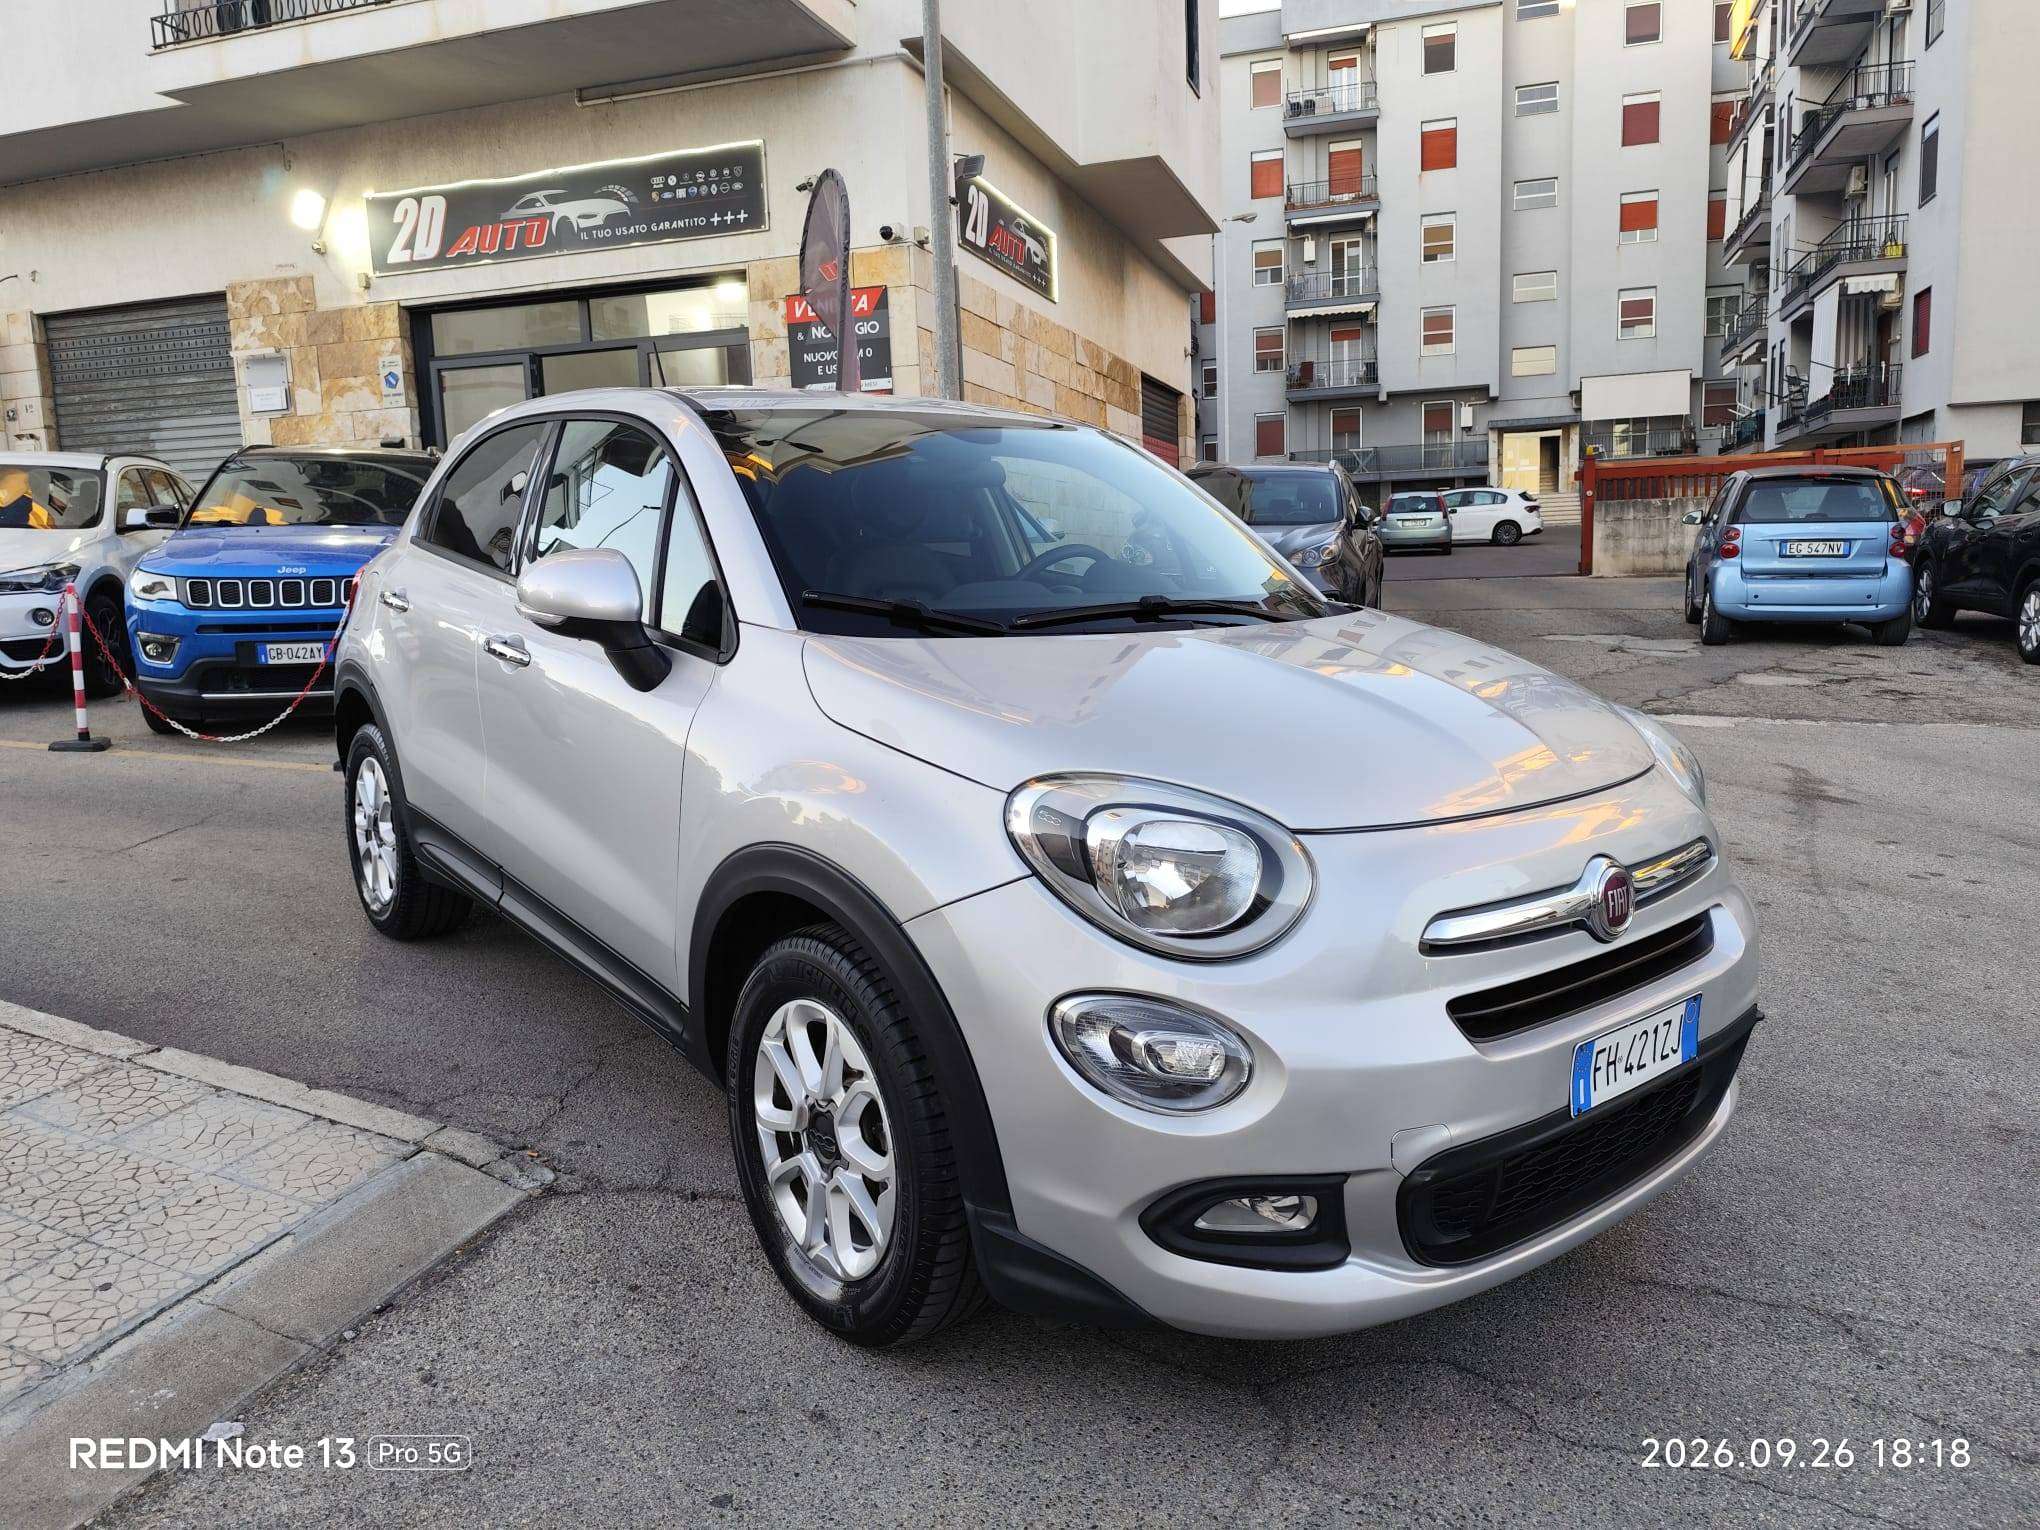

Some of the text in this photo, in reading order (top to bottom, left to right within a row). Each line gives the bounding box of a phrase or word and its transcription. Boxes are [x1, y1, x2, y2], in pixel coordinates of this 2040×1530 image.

[387, 195, 447, 263] 2D
[580, 231, 589, 241] IL
[592, 228, 612, 239] TUO
[615, 224, 648, 236] USATO
[651, 217, 706, 232] GARANTITO
[965, 185, 988, 248] 2D
[446, 216, 549, 257] AUTO
[988, 223, 1025, 265] AUTO
[797, 332, 804, 341] &
[277, 566, 307, 575] Jeep
[1608, 886, 1628, 918] FIAT
